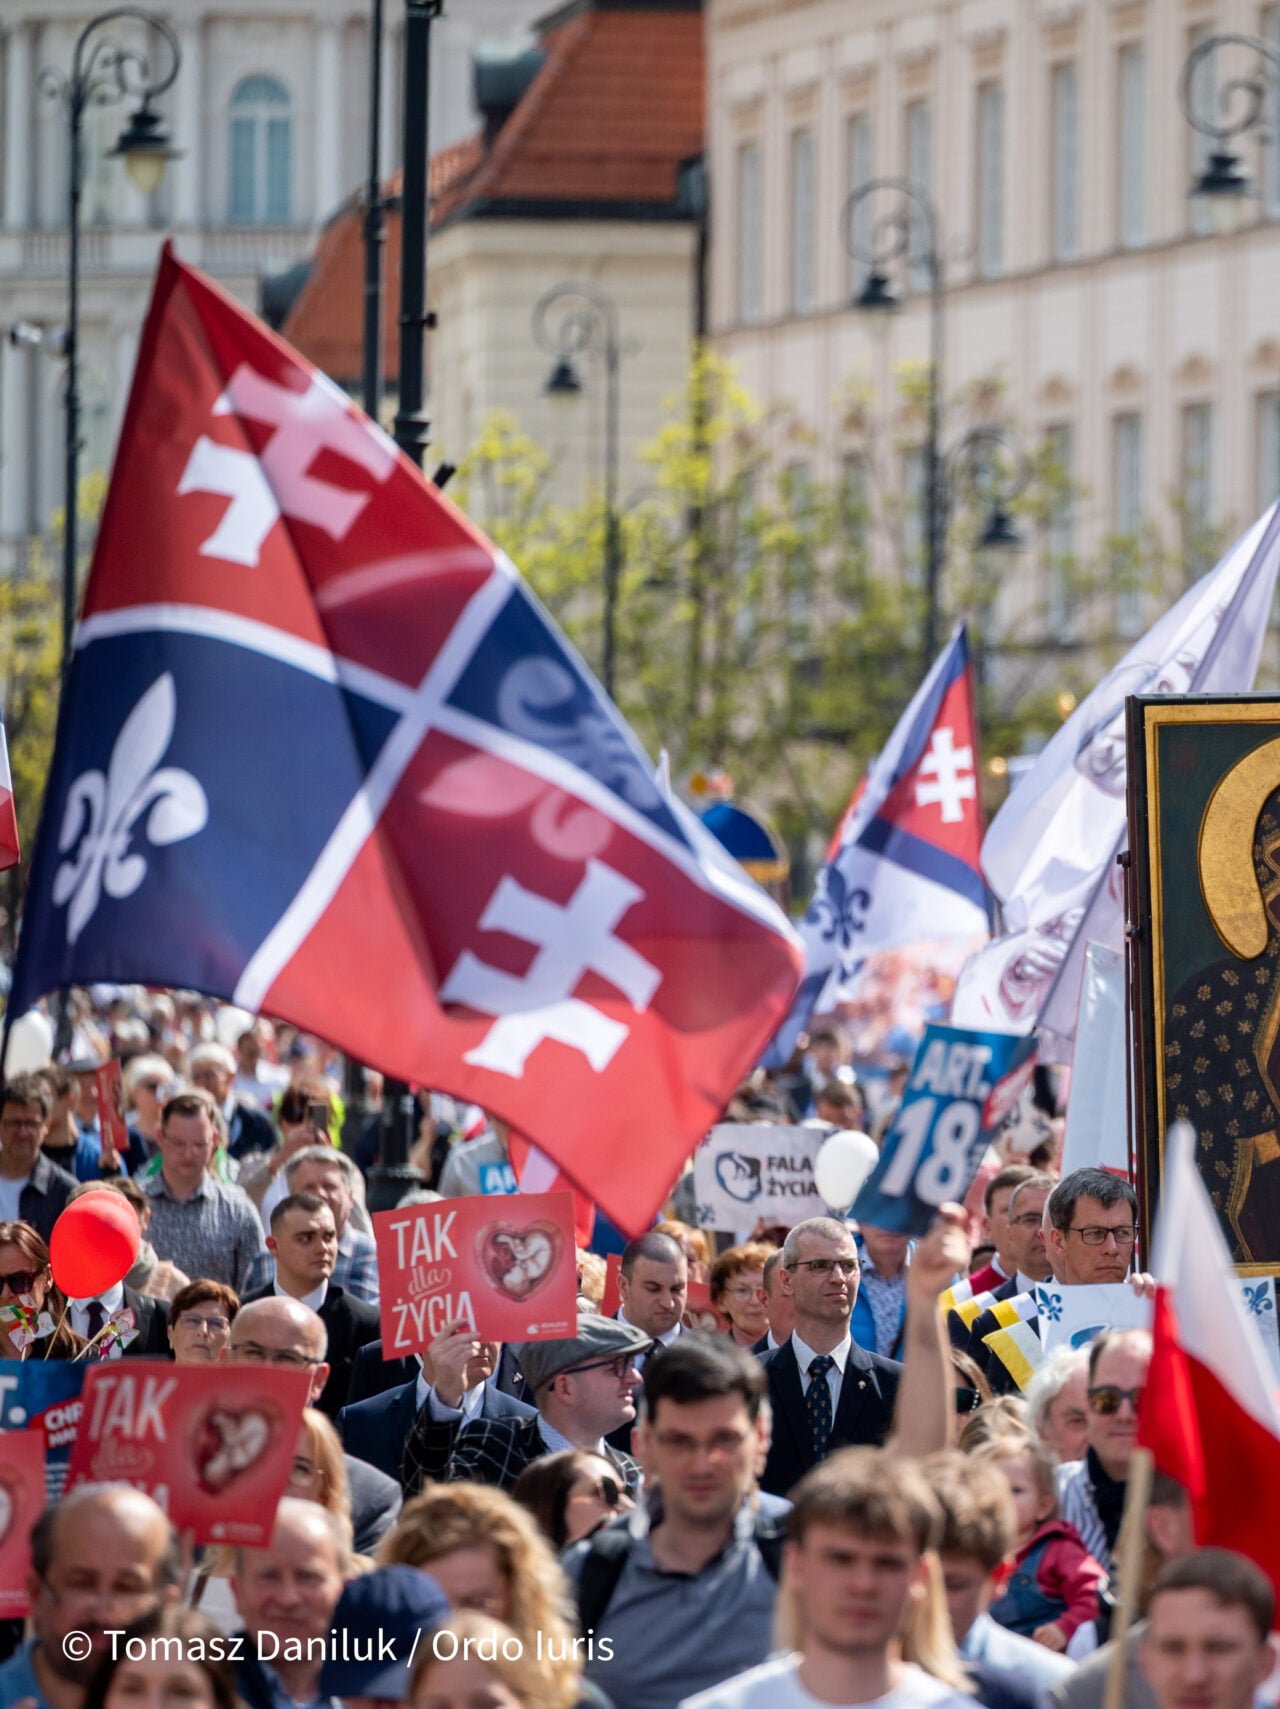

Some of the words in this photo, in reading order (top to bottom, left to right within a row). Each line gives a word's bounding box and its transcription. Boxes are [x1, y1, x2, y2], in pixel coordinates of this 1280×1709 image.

[913, 1038, 993, 1097] ART.
[767, 1156, 813, 1173] FALA
[878, 1096, 981, 1208] 18
[767, 1175, 819, 1197] ŻYCIA
[389, 1210, 458, 1270] TAK
[407, 1264, 452, 1301] dla
[392, 1291, 478, 1348] ŻYCIA
[88, 1374, 178, 1442] TAK
